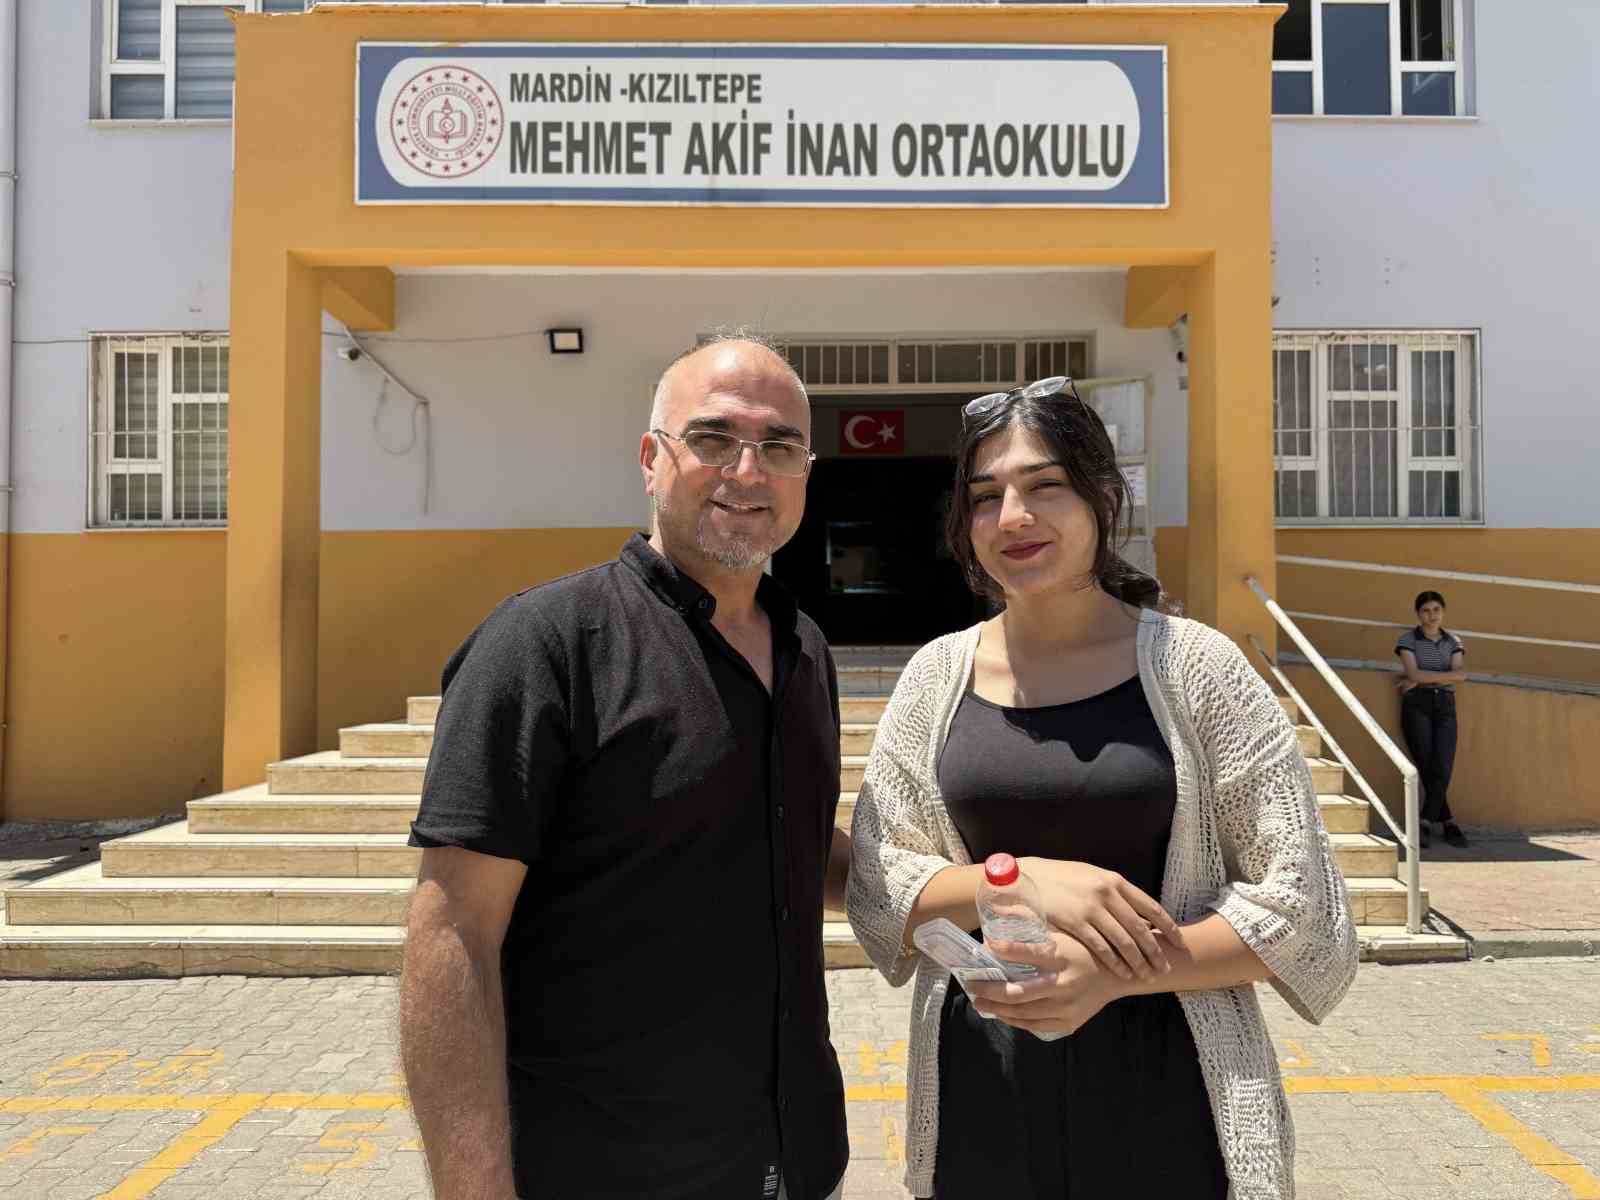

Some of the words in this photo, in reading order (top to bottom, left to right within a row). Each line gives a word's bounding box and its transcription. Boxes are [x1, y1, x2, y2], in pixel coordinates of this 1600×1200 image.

[510, 66, 611, 103] MARDİN
[510, 121, 672, 175] MEHMET
[684, 109, 773, 176] AKİF
[786, 109, 878, 177] İNAN
[892, 122, 1125, 178] ORTAOKULU
